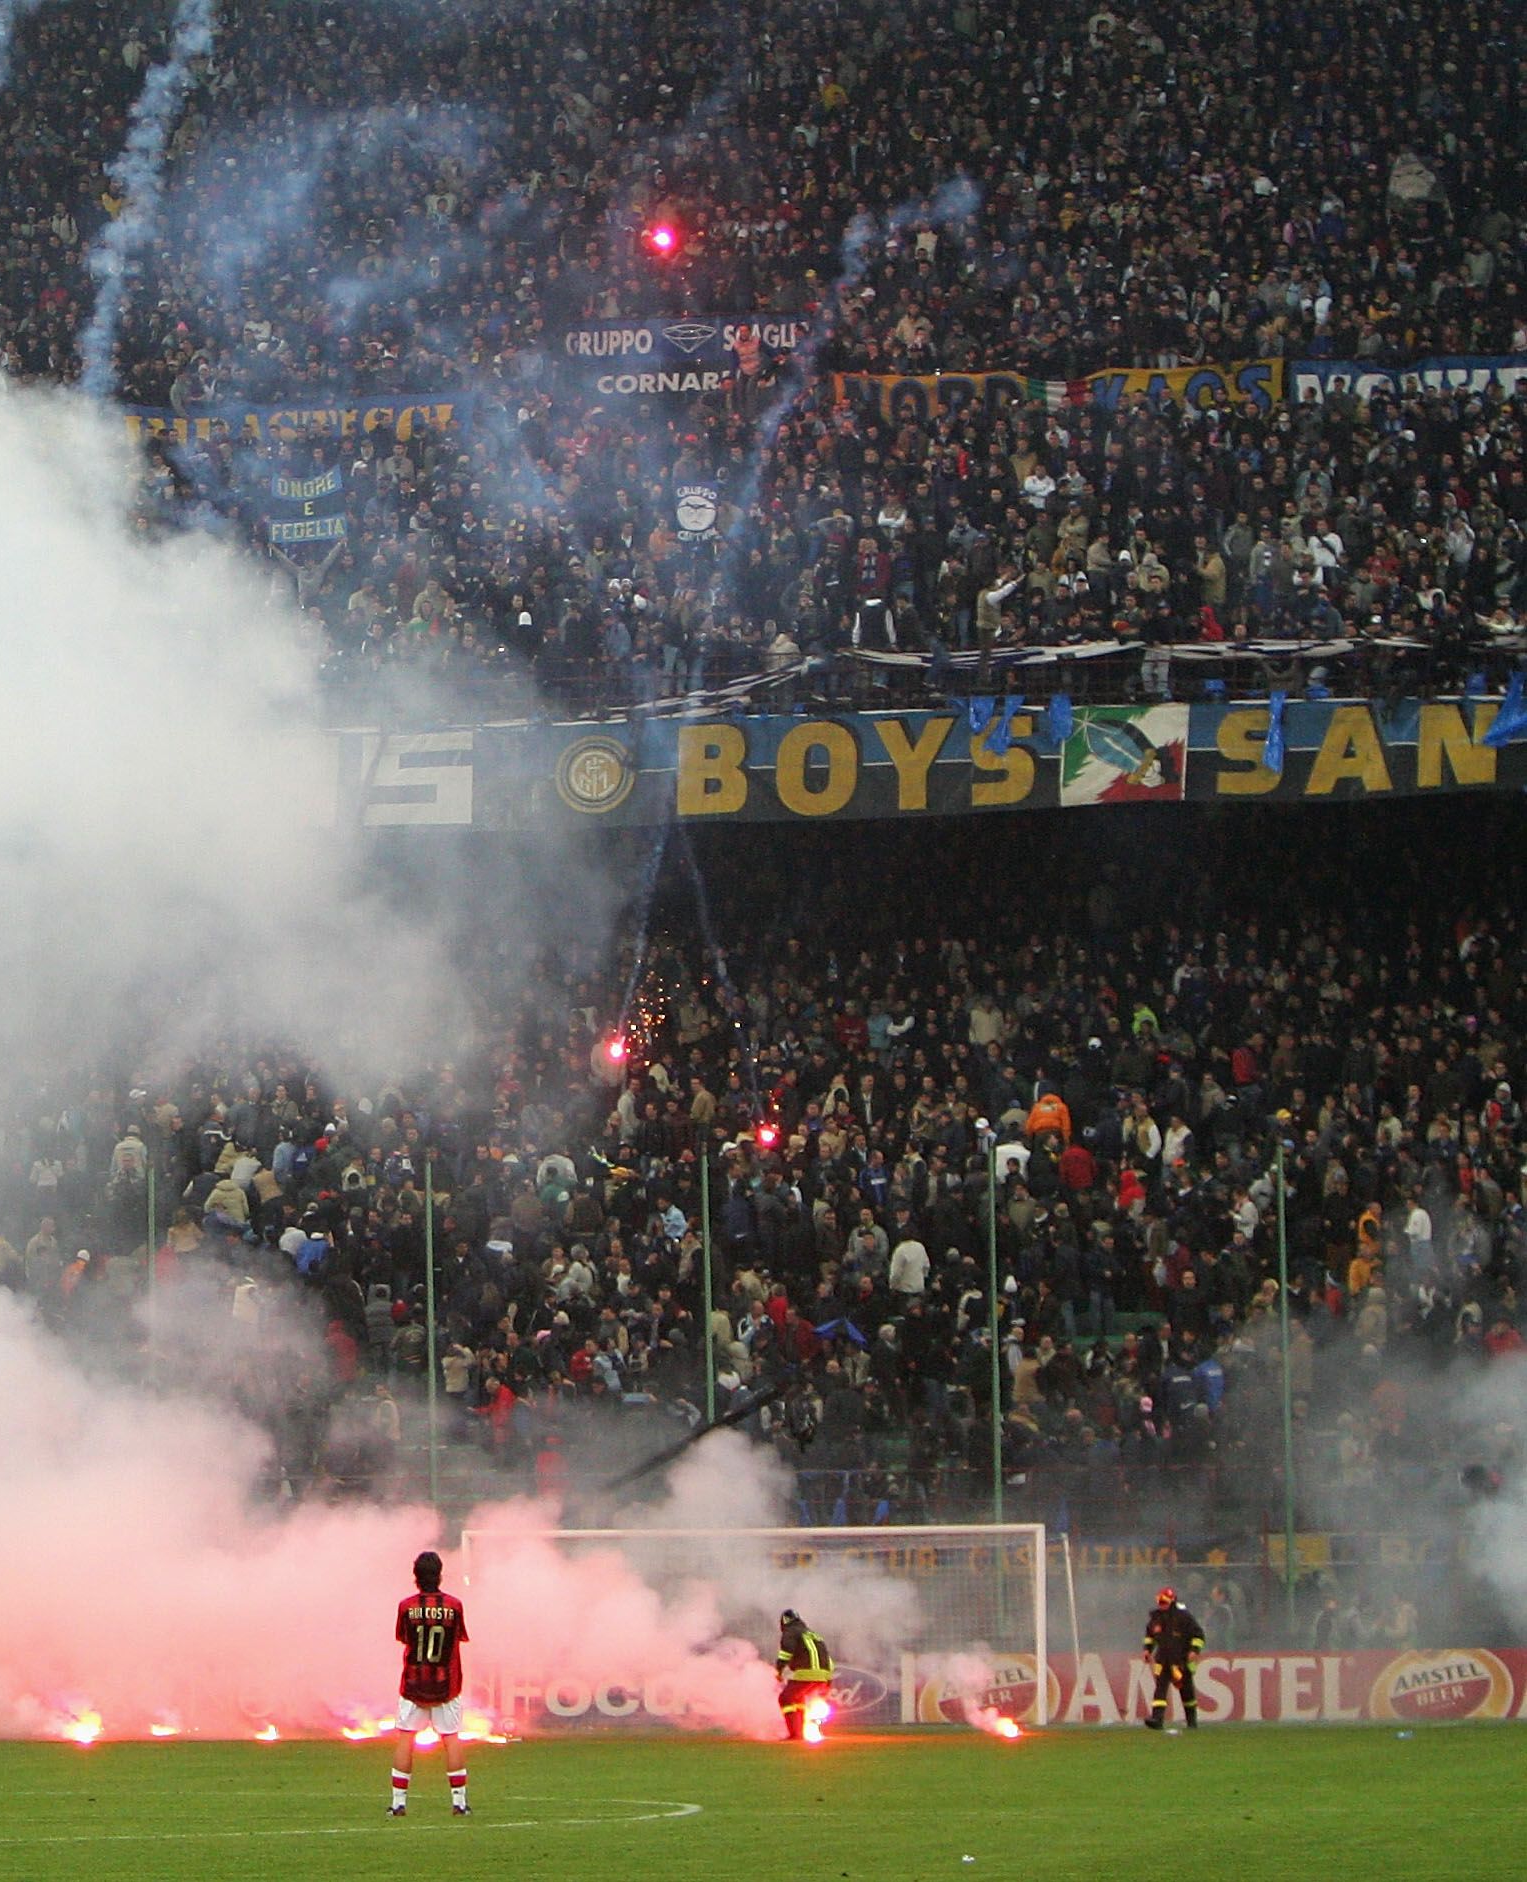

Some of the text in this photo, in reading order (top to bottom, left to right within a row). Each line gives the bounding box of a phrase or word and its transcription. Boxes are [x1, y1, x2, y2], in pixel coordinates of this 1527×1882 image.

[565, 329, 653, 356] GRUPPO
[304, 501, 314, 516] E
[1217, 703, 1499, 795] SAN
[676, 716, 1034, 816] BOYS
[416, 1625, 445, 1662] 10
[1395, 1664, 1485, 1692] AMSTEL
[1415, 1684, 1466, 1707] BEER
